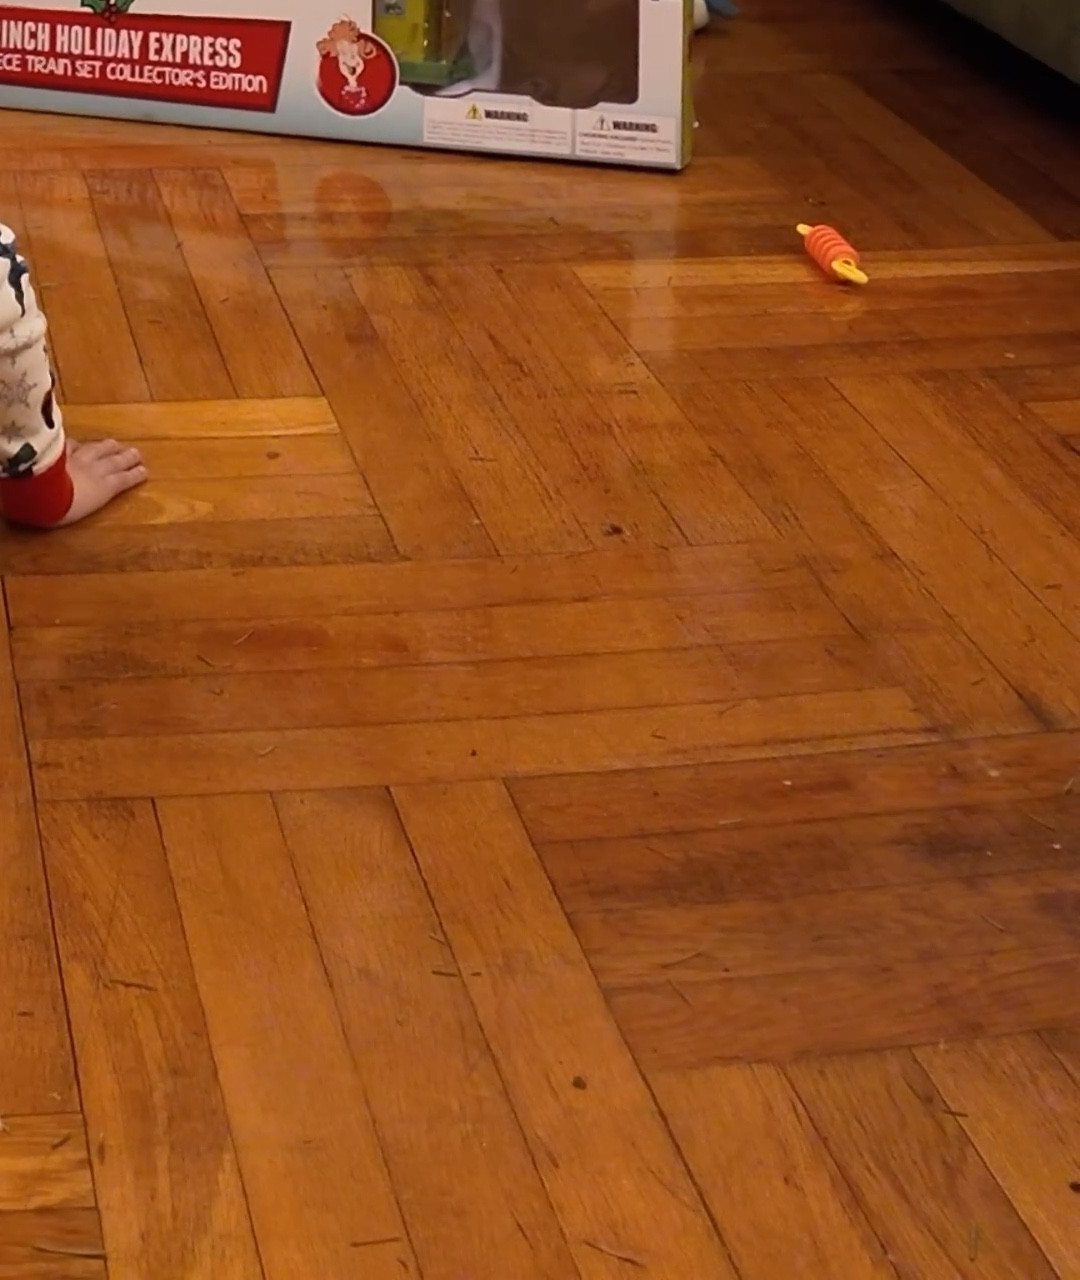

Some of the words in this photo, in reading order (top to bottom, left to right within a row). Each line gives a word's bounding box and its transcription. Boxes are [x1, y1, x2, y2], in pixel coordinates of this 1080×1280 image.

[55, 23, 144, 61] HOLIDAY
[148, 30, 242, 69] EXPRESS
[74, 59, 102, 79] SET
[105, 62, 206, 89] COLLECTOR'S
